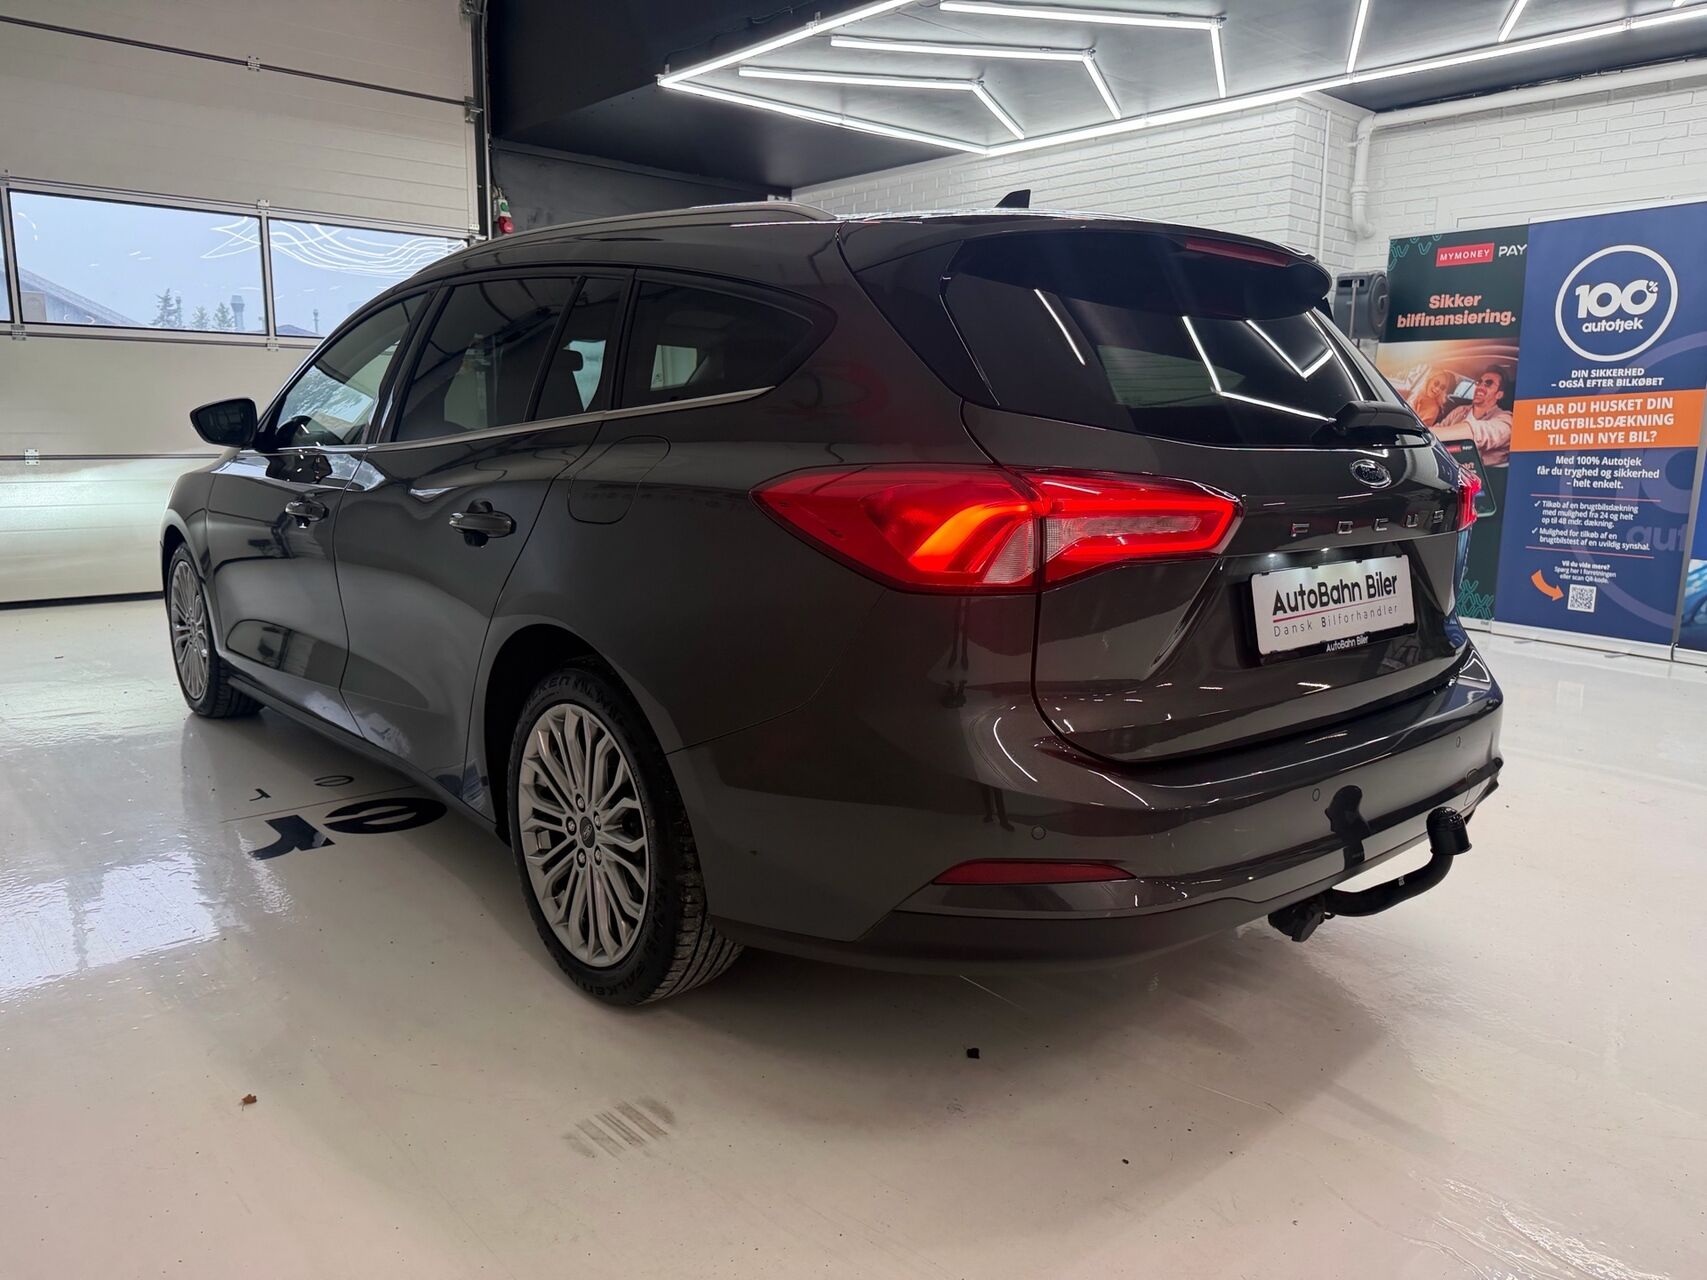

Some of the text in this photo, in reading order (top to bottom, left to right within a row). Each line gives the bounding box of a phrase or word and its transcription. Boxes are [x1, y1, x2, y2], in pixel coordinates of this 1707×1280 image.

[1440, 244, 1528, 261] MYMONEY PAY
[1428, 293, 1482, 309] Sikker
[1397, 309, 1516, 329] bilfinansiering.
[1582, 317, 1643, 333] autotjek
[1571, 368, 1644, 378] DIN SIKKERHED
[1558, 378, 1584, 388] OGSÅ
[1586, 379, 1614, 388] EFTER
[1616, 377, 1664, 387] BILKØBET
[1536, 397, 1674, 416] HAR DU HUSKET DIN
[1534, 413, 1674, 431] BRUGTBILSDÆKNING
[1548, 431, 1658, 445] TIL DIN NYE BIL?
[1555, 456, 1642, 467] Med 100% Autotjek
[1537, 466, 1660, 479] får du tryghed og sikkerhed
[1573, 480, 1591, 488] helt
[1592, 480, 1624, 489] enkelt.
[1542, 501, 1561, 509] Tilkøb
[1557, 510, 1588, 519] mulighed
[1619, 513, 1634, 521] helt
[1291, 510, 1444, 537] FOCUS
[1540, 528, 1568, 537] Mulighed
[1569, 529, 1579, 537] for
[1580, 530, 1599, 538] tilkøb
[1600, 531, 1608, 539] af
[1580, 538, 1588, 546] af
[1598, 539, 1621, 549] uvildig
[1272, 571, 1398, 616] AutoBahn Biler
[1274, 604, 1398, 637] Dansk Bilforhandler
[1326, 635, 1369, 652] AutoBahn Biler
